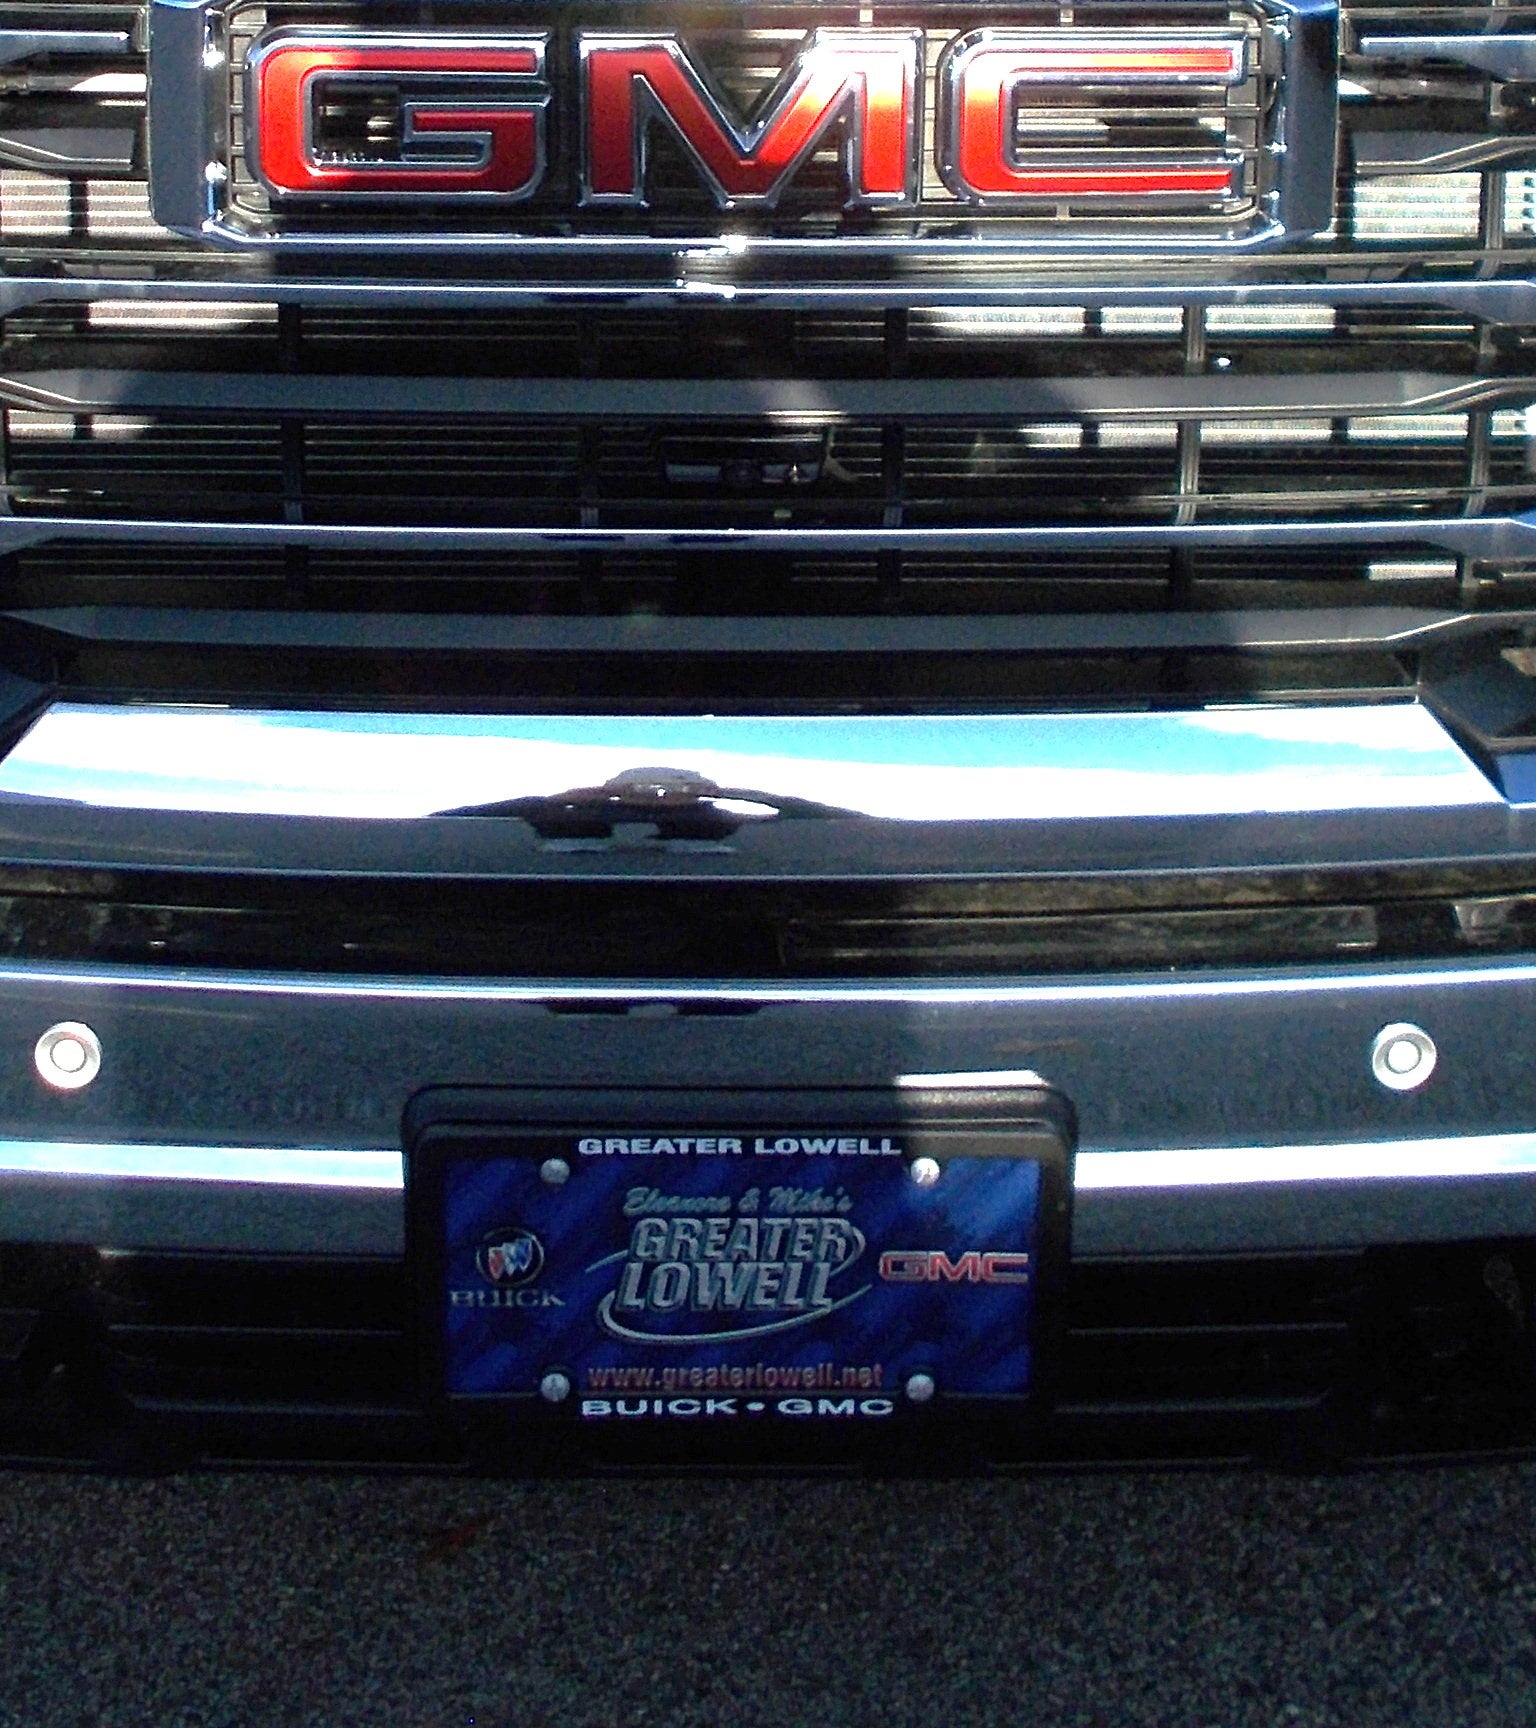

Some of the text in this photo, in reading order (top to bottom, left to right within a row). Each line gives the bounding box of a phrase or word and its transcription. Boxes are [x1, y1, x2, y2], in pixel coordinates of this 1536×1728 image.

[246, 26, 1250, 210] GMC
[578, 1137, 902, 1155] GREATER LOWELL
[629, 1217, 852, 1262] GREATER
[879, 1251, 1029, 1283] GMC
[450, 1290, 567, 1308] BUICK
[615, 1260, 833, 1311] LOWELL
[587, 1362, 883, 1390] www.greaterlowell.net
[581, 1398, 895, 1416] BUICK GMC
